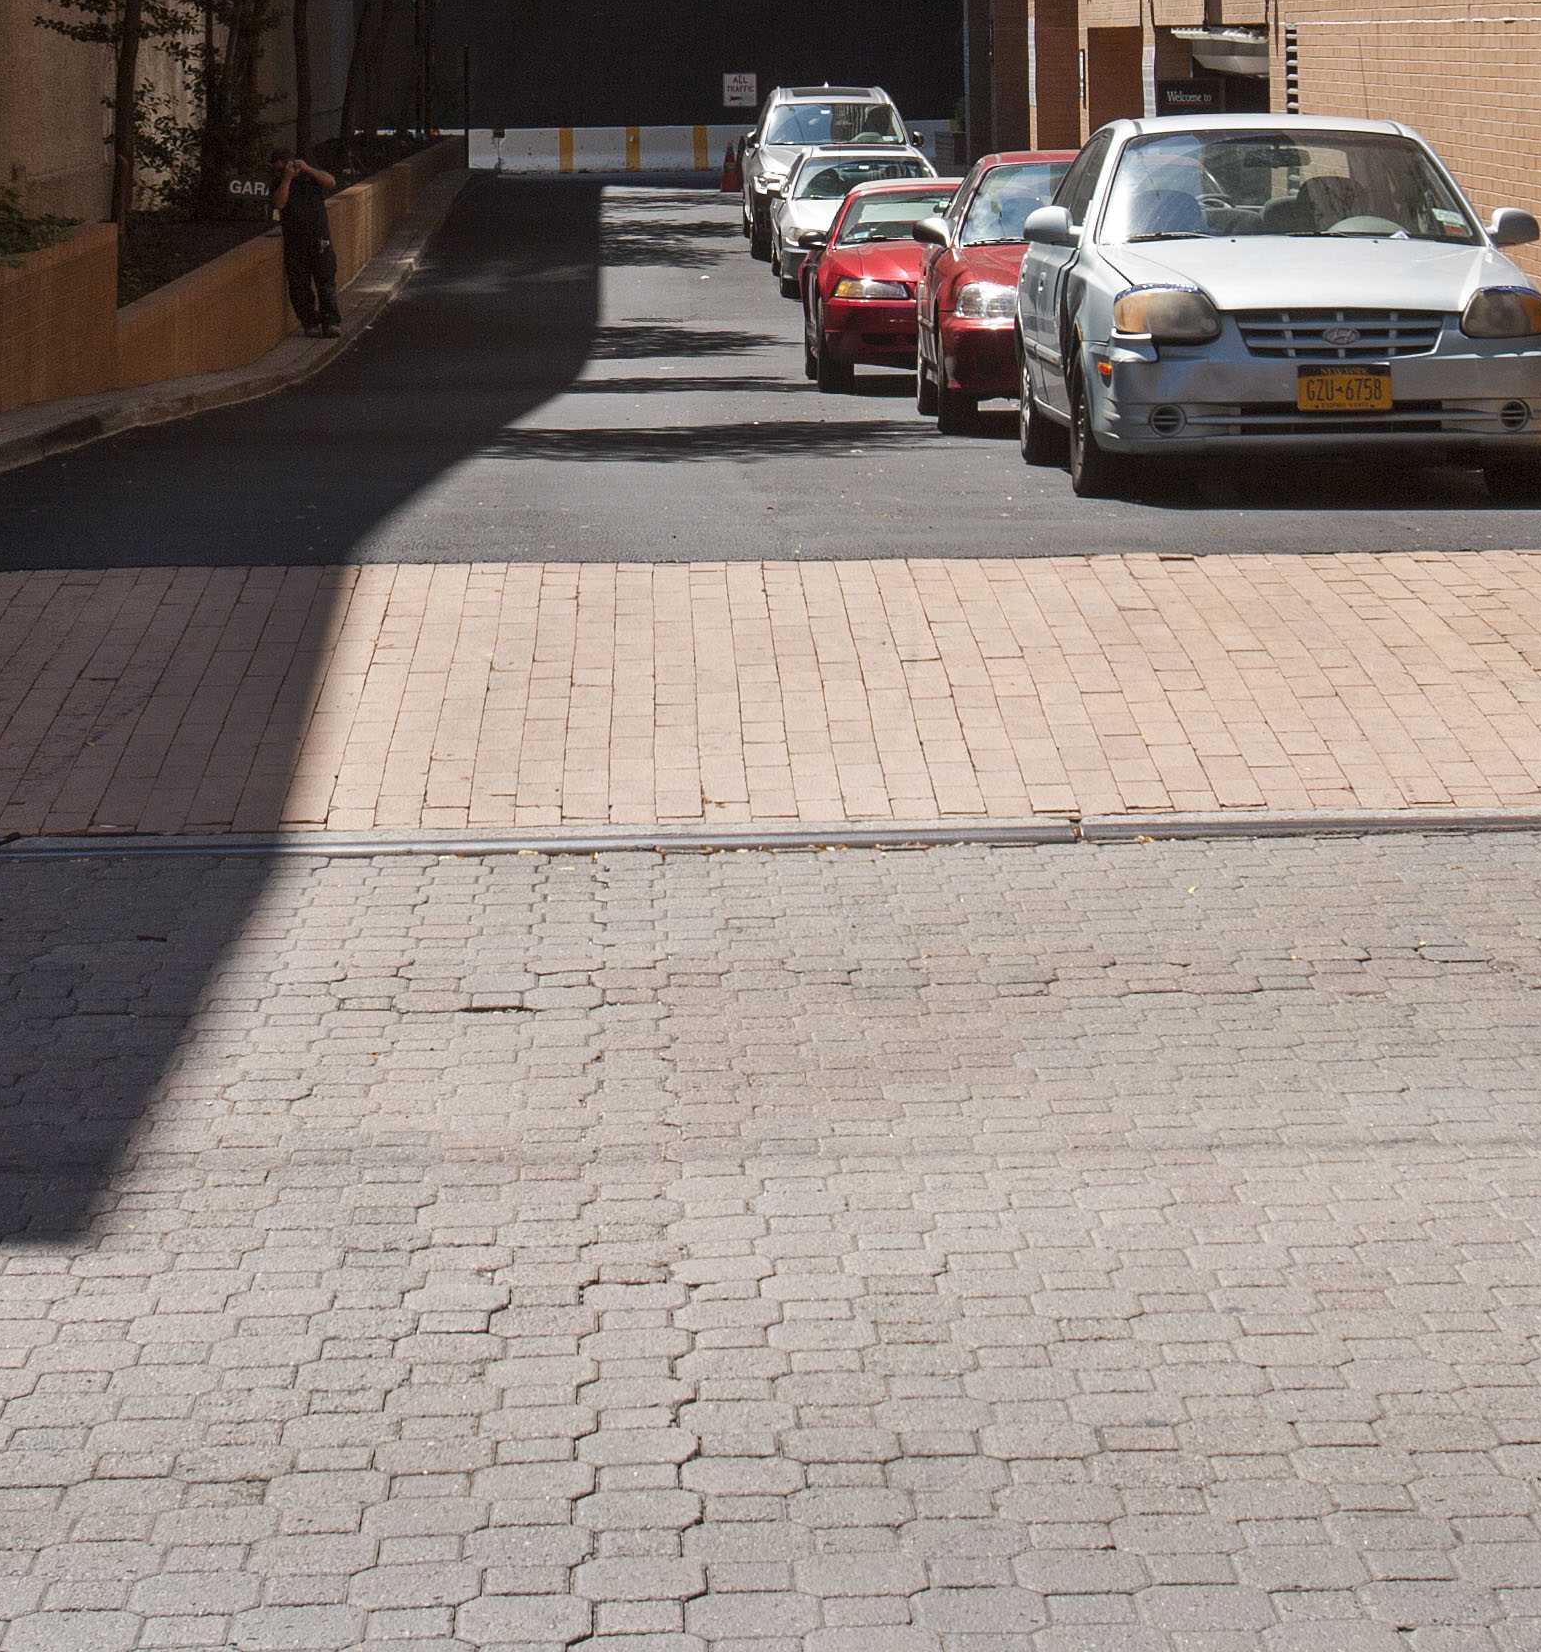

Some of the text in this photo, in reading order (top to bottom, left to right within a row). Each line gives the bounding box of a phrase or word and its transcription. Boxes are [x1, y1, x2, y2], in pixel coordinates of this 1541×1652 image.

[1166, 90, 1212, 103] Welcome to
[229, 180, 270, 196] GAR
